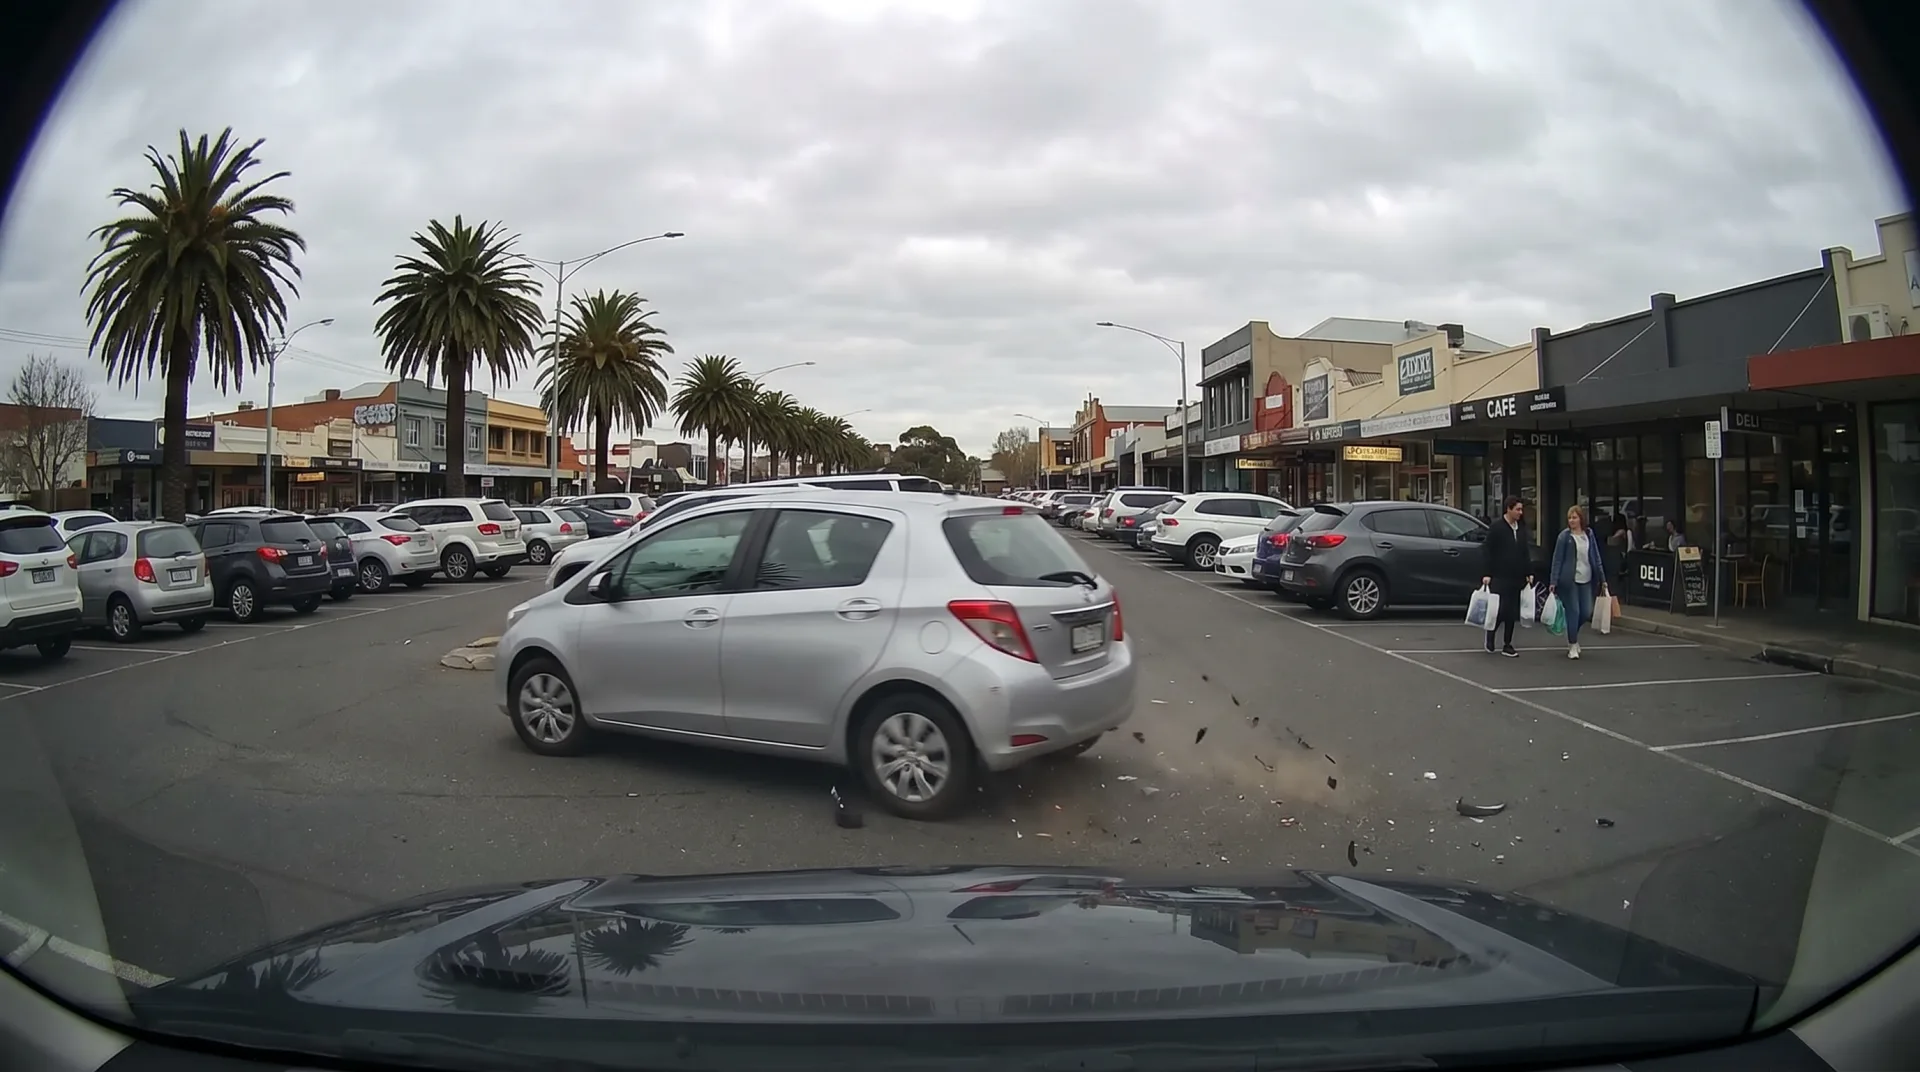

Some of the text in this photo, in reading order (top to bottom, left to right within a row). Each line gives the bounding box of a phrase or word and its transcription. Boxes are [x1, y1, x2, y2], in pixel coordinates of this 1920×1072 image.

[1735, 413, 1760, 428] DELI
[1530, 433, 1559, 447] DELI
[1640, 564, 1664, 582] DELI
